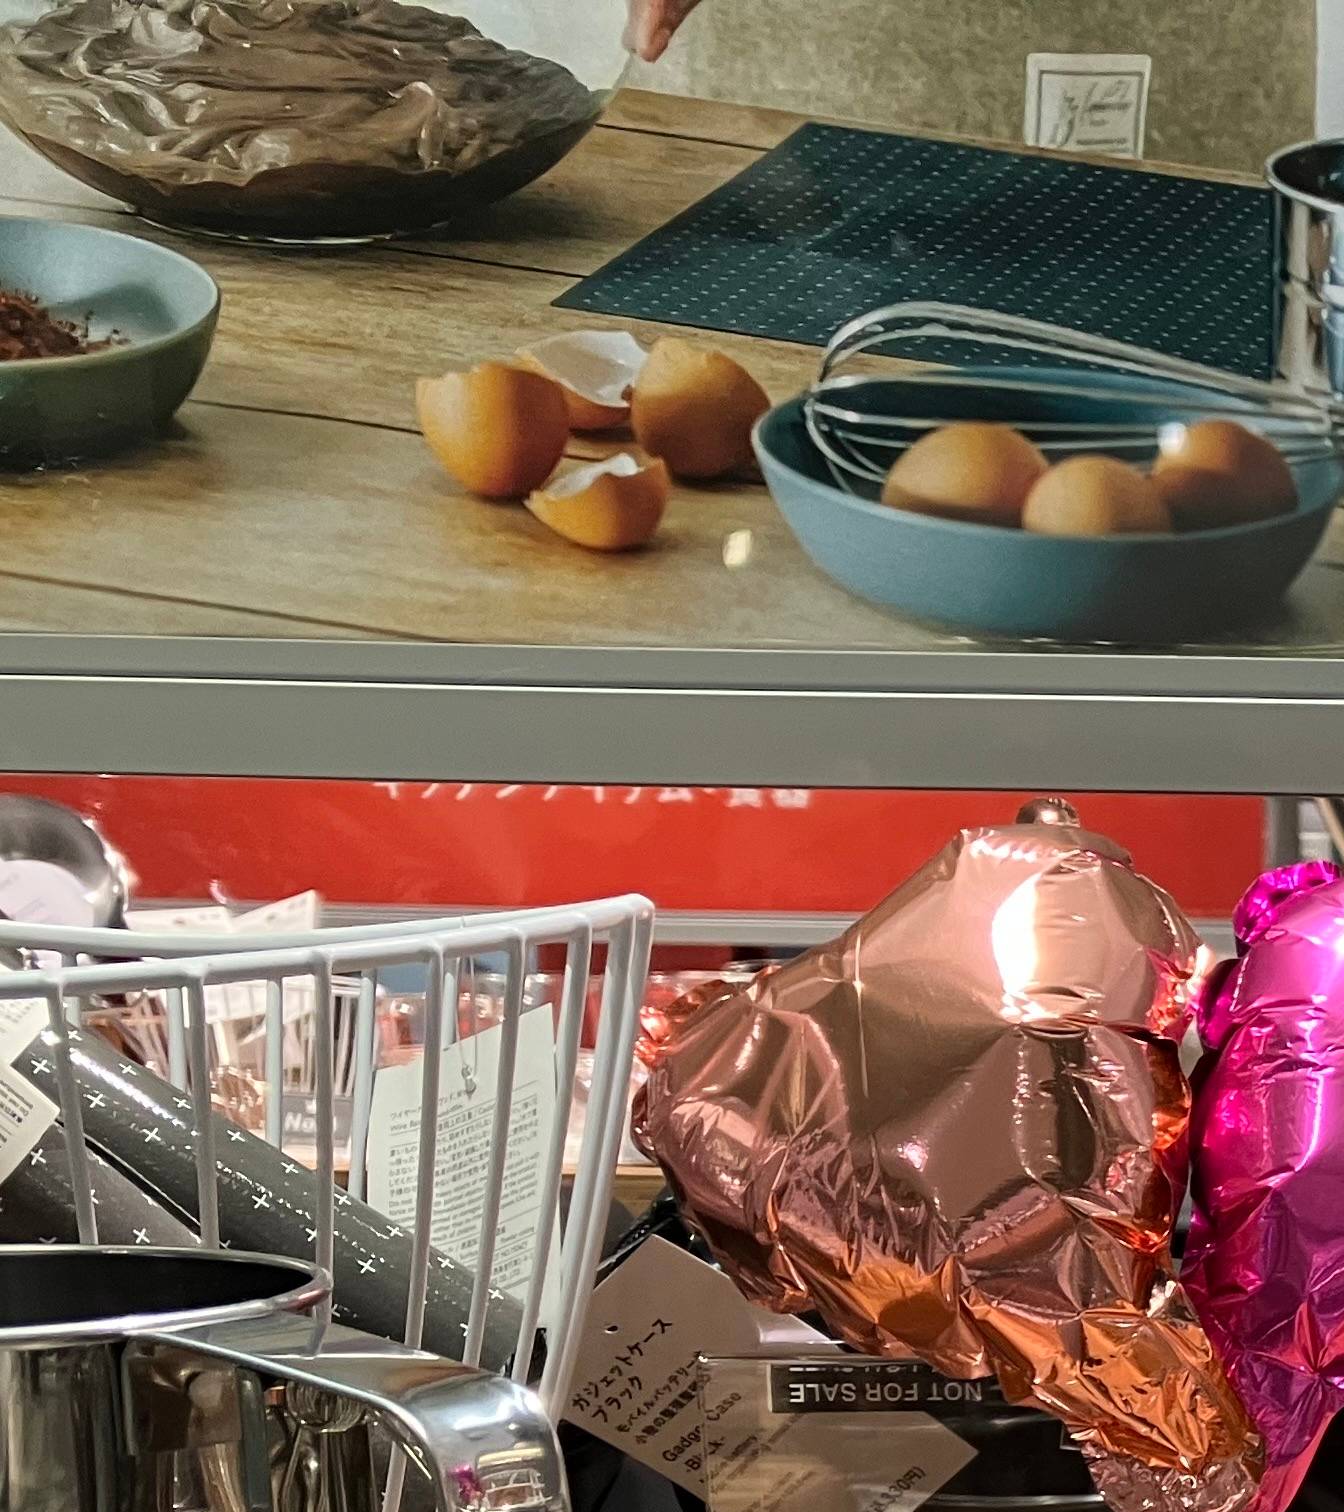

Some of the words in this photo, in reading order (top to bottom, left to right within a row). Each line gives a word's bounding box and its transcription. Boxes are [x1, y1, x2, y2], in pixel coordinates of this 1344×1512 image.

[593, 1374, 643, 1422] ブラック
[789, 1383, 856, 1403] SALE
[865, 1382, 918, 1401] FOR
[928, 1382, 982, 1401] NOT
